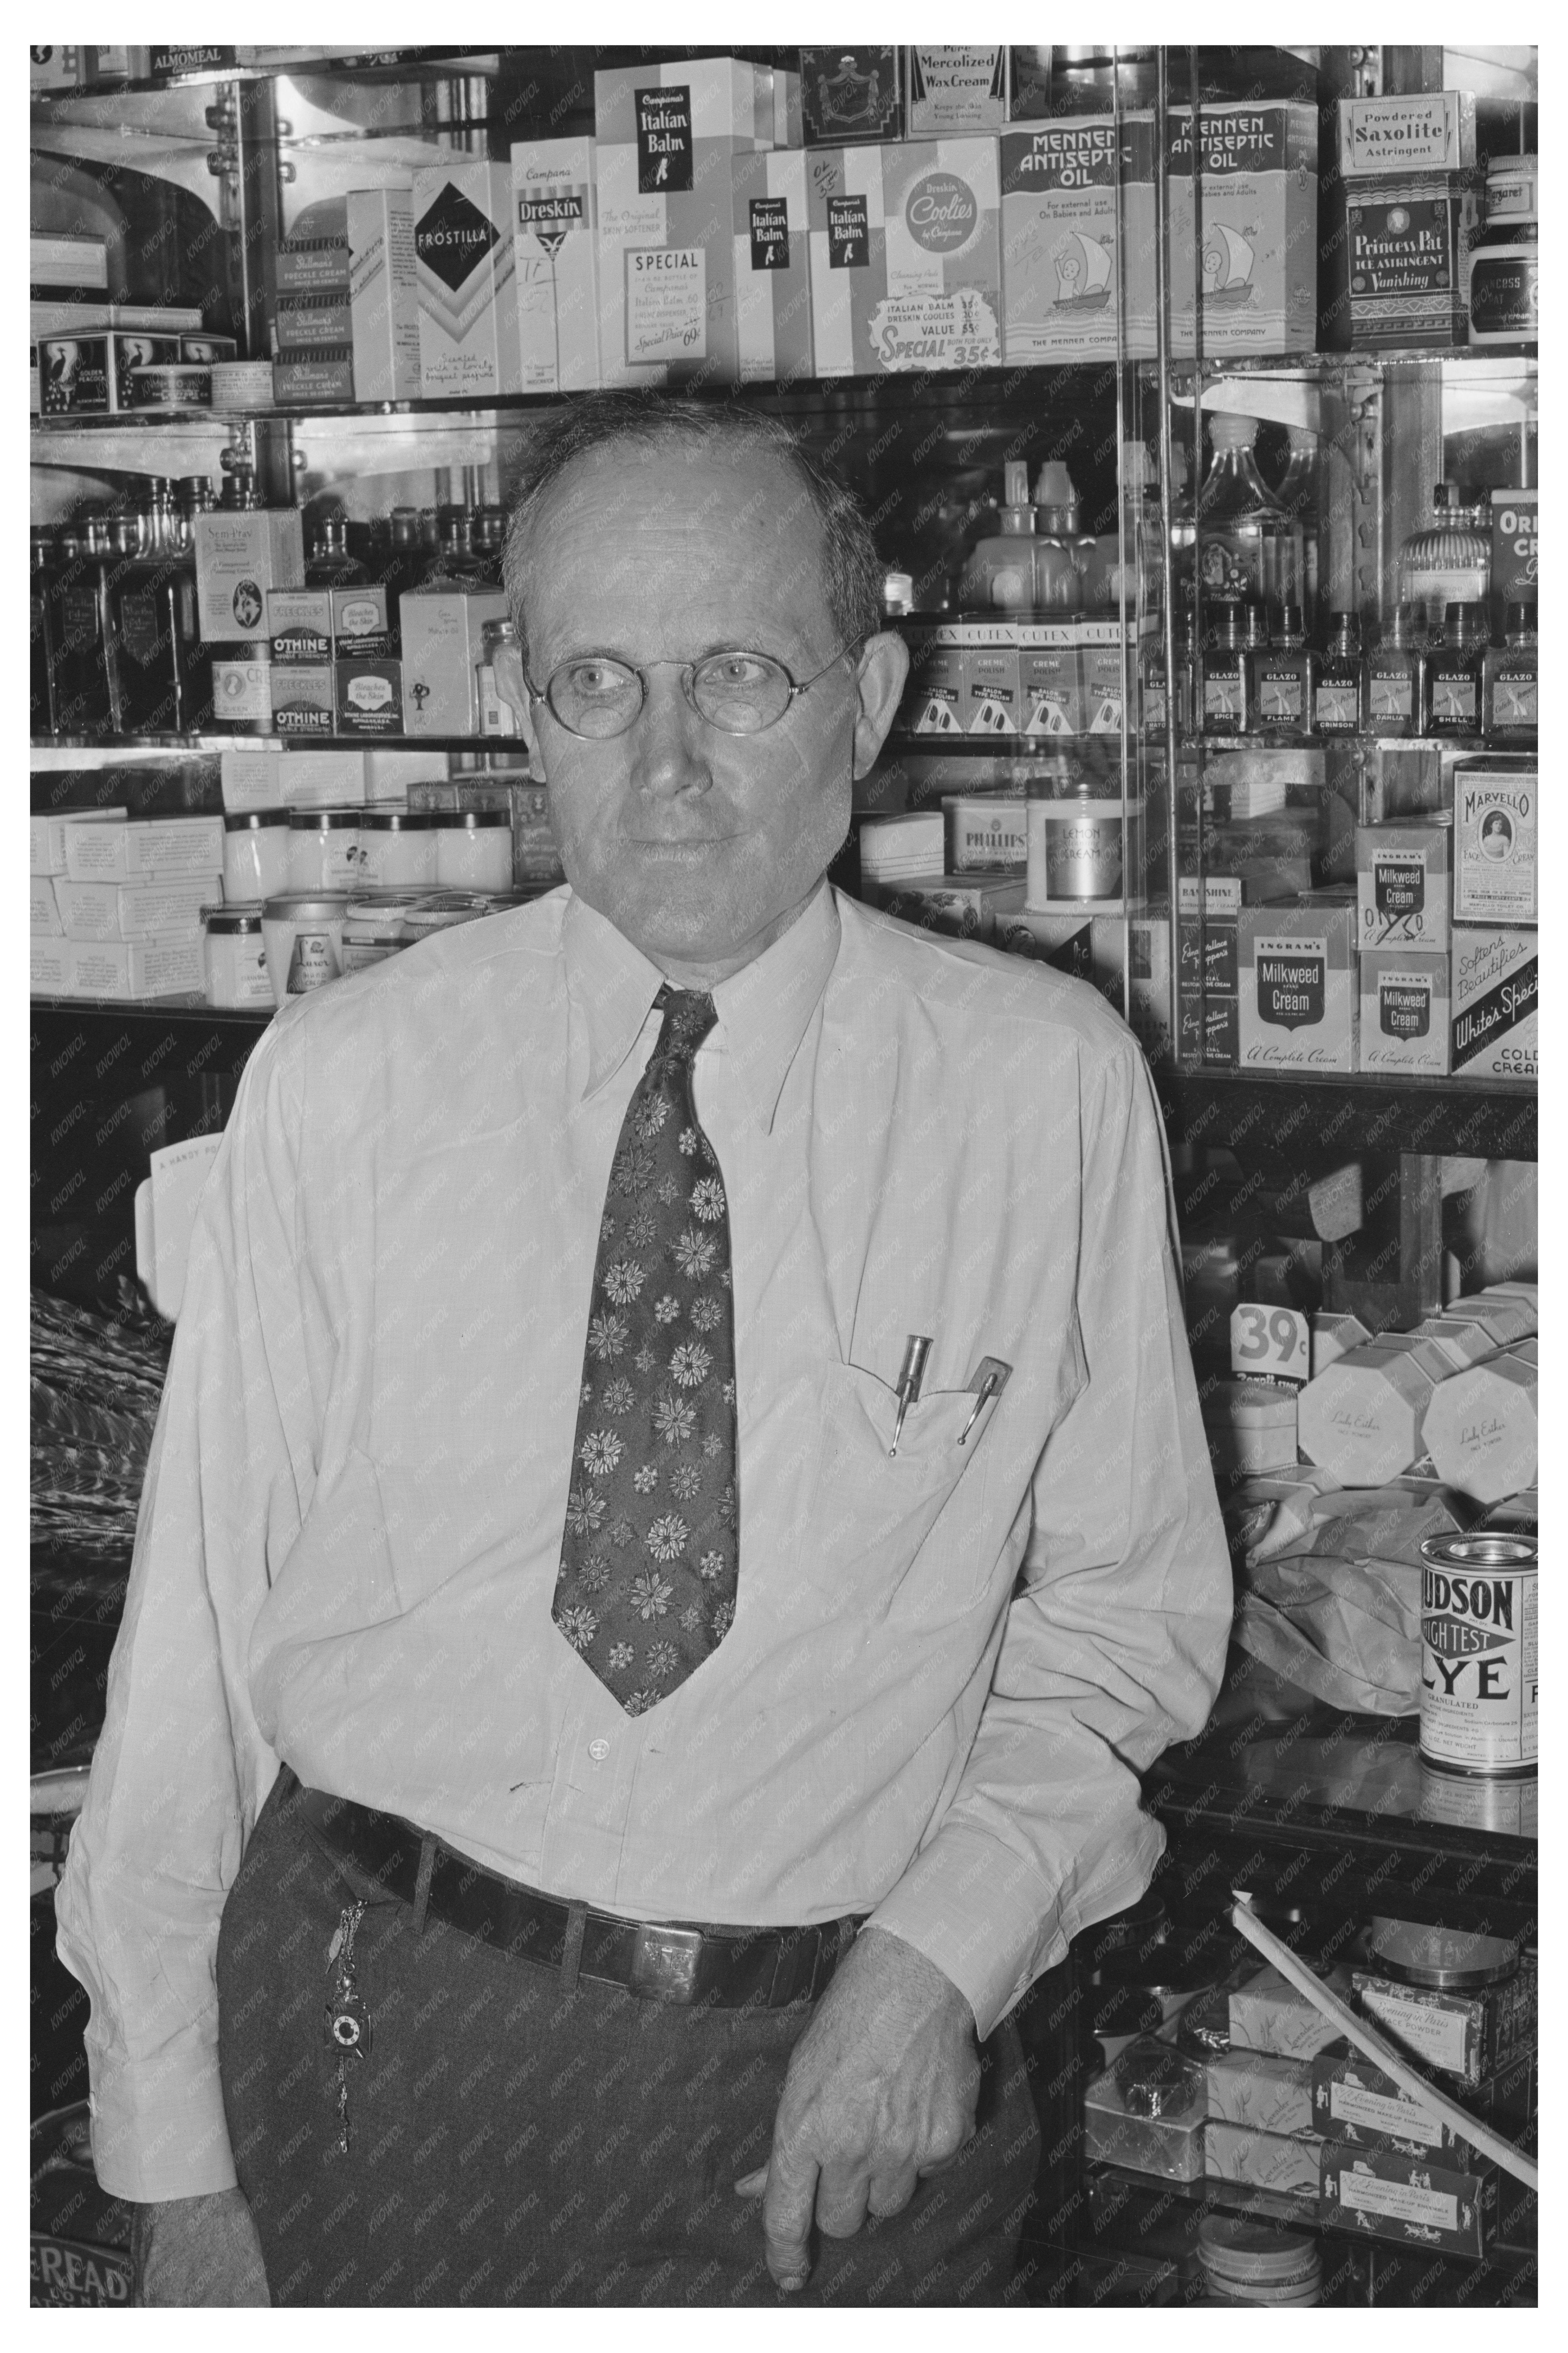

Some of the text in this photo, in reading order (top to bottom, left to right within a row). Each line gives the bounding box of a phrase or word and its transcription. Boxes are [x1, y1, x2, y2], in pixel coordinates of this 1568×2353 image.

[154, 48, 221, 70] ALMOMEAL
[922, 53, 995, 69] Mercolized
[926, 75, 990, 88] Wax Cream
[642, 93, 684, 108] Campana's
[640, 110, 688, 131] Italian
[1364, 111, 1432, 123] Powdered
[1355, 123, 1443, 143] Saxolite
[648, 133, 685, 153] Balm
[1365, 144, 1432, 157] Astringent
[1210, 153, 1238, 168] OIL
[526, 168, 571, 182] Campana
[1060, 168, 1093, 186] OIL
[926, 182, 958, 194] Dreskin
[520, 199, 581, 221] Dreskin
[910, 194, 972, 225] Coolies
[1047, 201, 1059, 210] For
[1061, 199, 1091, 209] external
[753, 212, 786, 227] Italian
[830, 210, 865, 225] Italian
[1039, 207, 1091, 219] On Babies and
[418, 229, 488, 247] FROSTILLA
[756, 227, 784, 242] Balm
[834, 225, 863, 240] Balm
[1355, 230, 1444, 256] Princess Pat
[636, 252, 698, 270] SPECIAL
[1355, 254, 1444, 270] ICE ASTRINGENT
[284, 269, 347, 281] FRECKLE CREAM
[1371, 271, 1429, 293] Vanishing
[887, 302, 955, 313] ITALIAN BALM
[887, 312, 955, 323] DRESKIN COOLIES
[319, 326, 345, 336] CREAM
[922, 325, 955, 335] VALUE
[635, 329, 665, 353] Special
[880, 325, 990, 365] SPECIAL 35¢
[1032, 337, 1085, 347] THE MENNEN
[968, 629, 1014, 641] CUTEX
[1022, 629, 1071, 641] CUTEX
[274, 638, 328, 651] OTHINE
[1266, 673, 1297, 681] GLAZO
[1322, 679, 1353, 687] GLAZO
[1376, 672, 1408, 680] GLAZO
[1438, 673, 1470, 682] GLAZO
[1500, 673, 1533, 682] GLAZO
[983, 687, 1002, 695] SALON
[1046, 695, 1066, 703] POLISH
[276, 712, 330, 725] OTHINE
[1376, 714, 1404, 722] DAHLIA
[1439, 715, 1468, 723] SHELL
[1465, 791, 1530, 823] MARVELLO
[1062, 828, 1101, 840] LEMON
[1463, 849, 1535, 865] FACE CREAM
[1379, 868, 1420, 884] Milkweed
[1386, 888, 1414, 904] Cream
[1260, 941, 1321, 950] INGRAM'S
[1459, 936, 1506, 976] Softens
[1263, 963, 1319, 984] Milkweed
[1457, 942, 1528, 1001] Beautifies
[1273, 989, 1309, 1011] Cream
[1384, 991, 1426, 1008] Milkweed
[1391, 1011, 1419, 1027] Cream
[1456, 1007, 1502, 1049] White's
[1247, 1045, 1338, 1065] A Complete Cream
[1382, 1051, 1414, 1066] Complete
[1417, 1054, 1441, 1067] Cream
[169, 1150, 199, 1164] HANDY
[1331, 1410, 1380, 1431] Lady Esther
[1459, 1417, 1507, 1446] Lady Esther
[1424, 1568, 1514, 1632] UDSON
[1424, 1621, 1490, 1652] HIGH TEST
[1427, 1693, 1479, 1710] GRANULATED
[1442, 1708, 1474, 1717] INGREDIENTS
[1455, 1741, 1477, 1750] WEIGHT
[1377, 2001, 1413, 2021] Evening
[1424, 2013, 1449, 2028] Paris
[1382, 2017, 1442, 2036] FACE POWDER
[1350, 2093, 1387, 2111] Evening
[1365, 2180, 1399, 2195] Evening
[30, 2246, 128, 2300] READ
